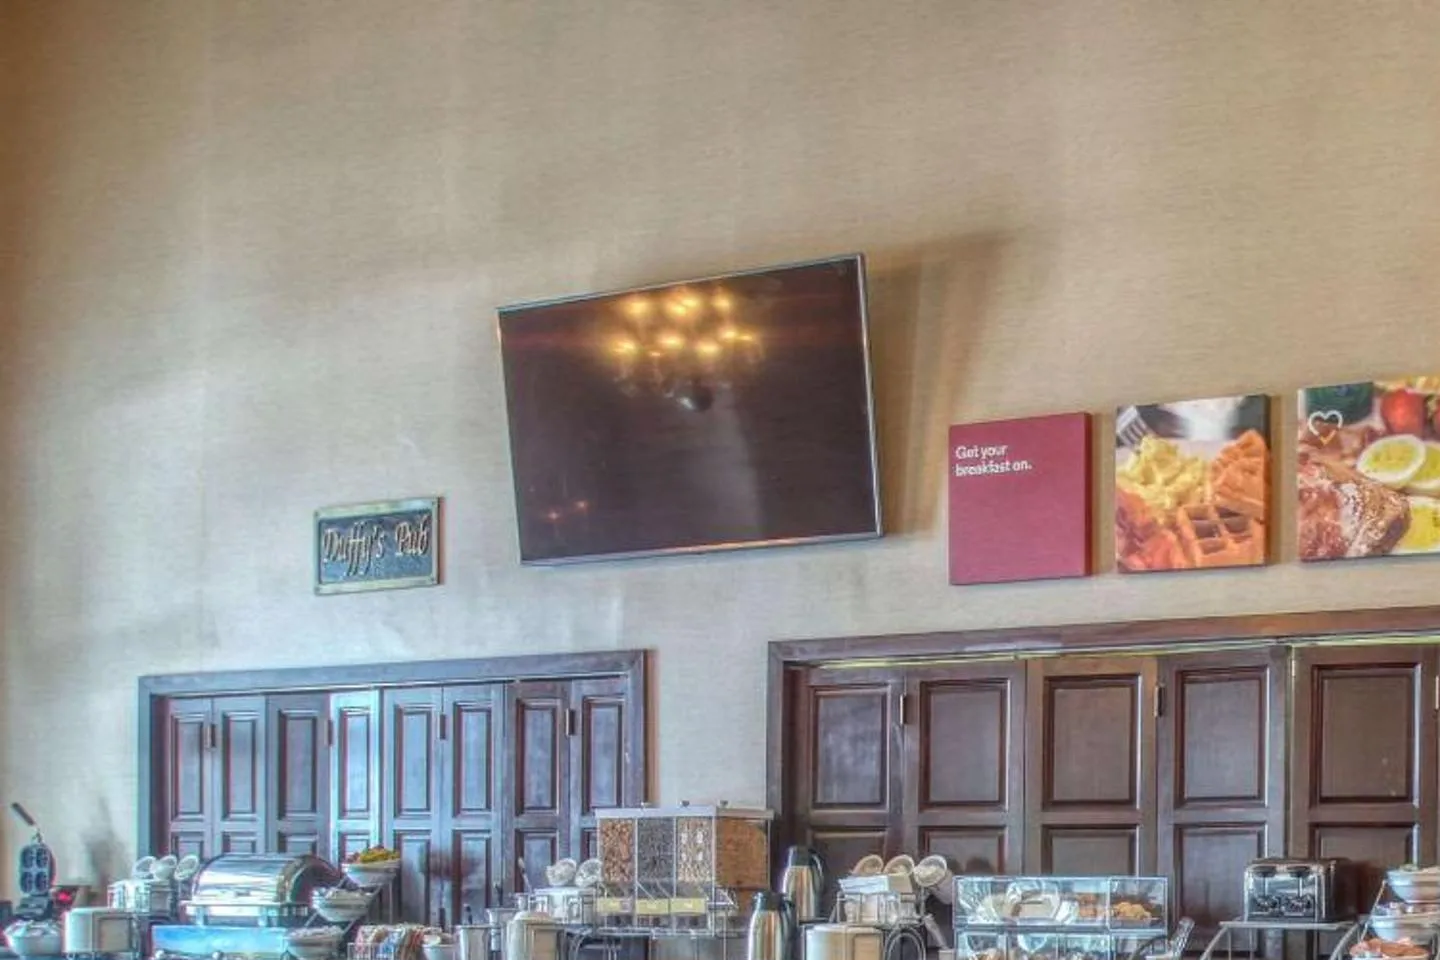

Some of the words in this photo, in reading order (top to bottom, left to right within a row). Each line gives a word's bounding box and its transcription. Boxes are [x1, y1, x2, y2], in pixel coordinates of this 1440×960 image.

[955, 445, 980, 459] Get
[981, 444, 1008, 459] your
[955, 460, 1011, 477] breakfast
[1012, 460, 1033, 472] on.
[322, 521, 385, 577] Duffy's
[395, 514, 429, 556] Pub
